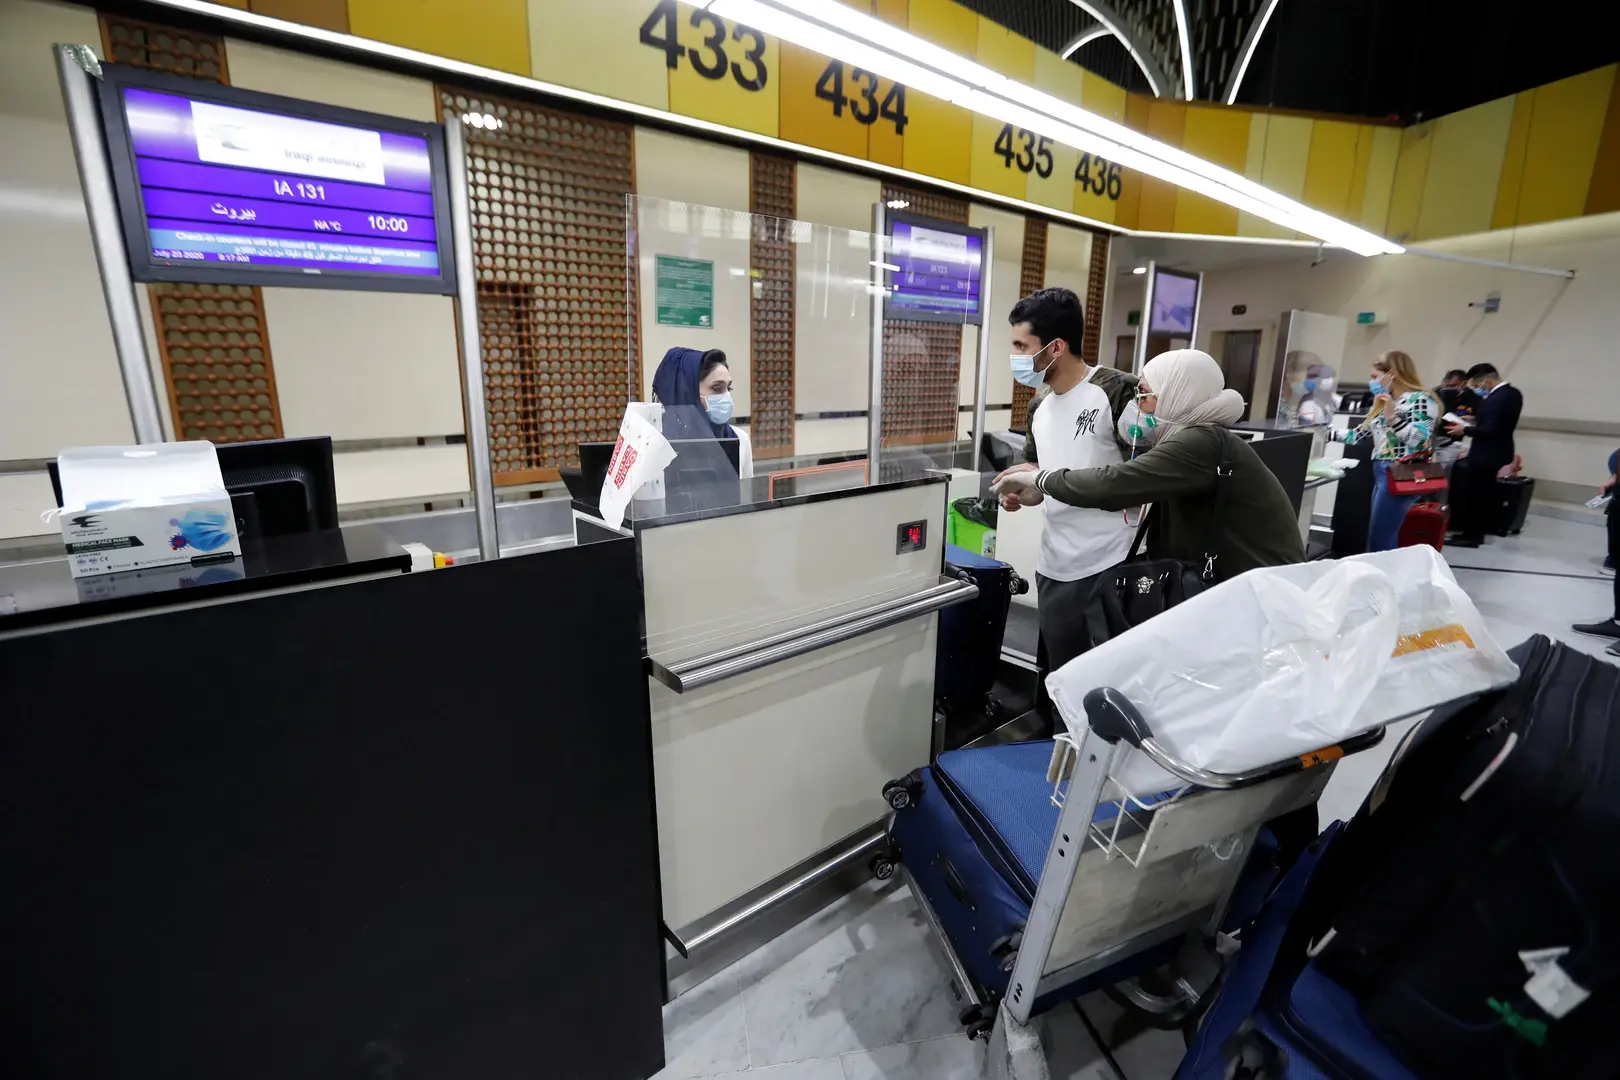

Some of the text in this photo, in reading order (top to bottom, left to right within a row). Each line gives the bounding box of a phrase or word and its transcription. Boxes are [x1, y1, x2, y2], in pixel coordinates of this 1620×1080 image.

[639, 0, 768, 92] 433
[815, 59, 909, 136] 434
[994, 122, 1054, 179] 435
[273, 179, 326, 201] IA 131
[1075, 152, 1123, 200] 436
[211, 201, 257, 221] بيروت
[368, 215, 409, 233] 10:00
[72, 540, 98, 548] MEDICAL
